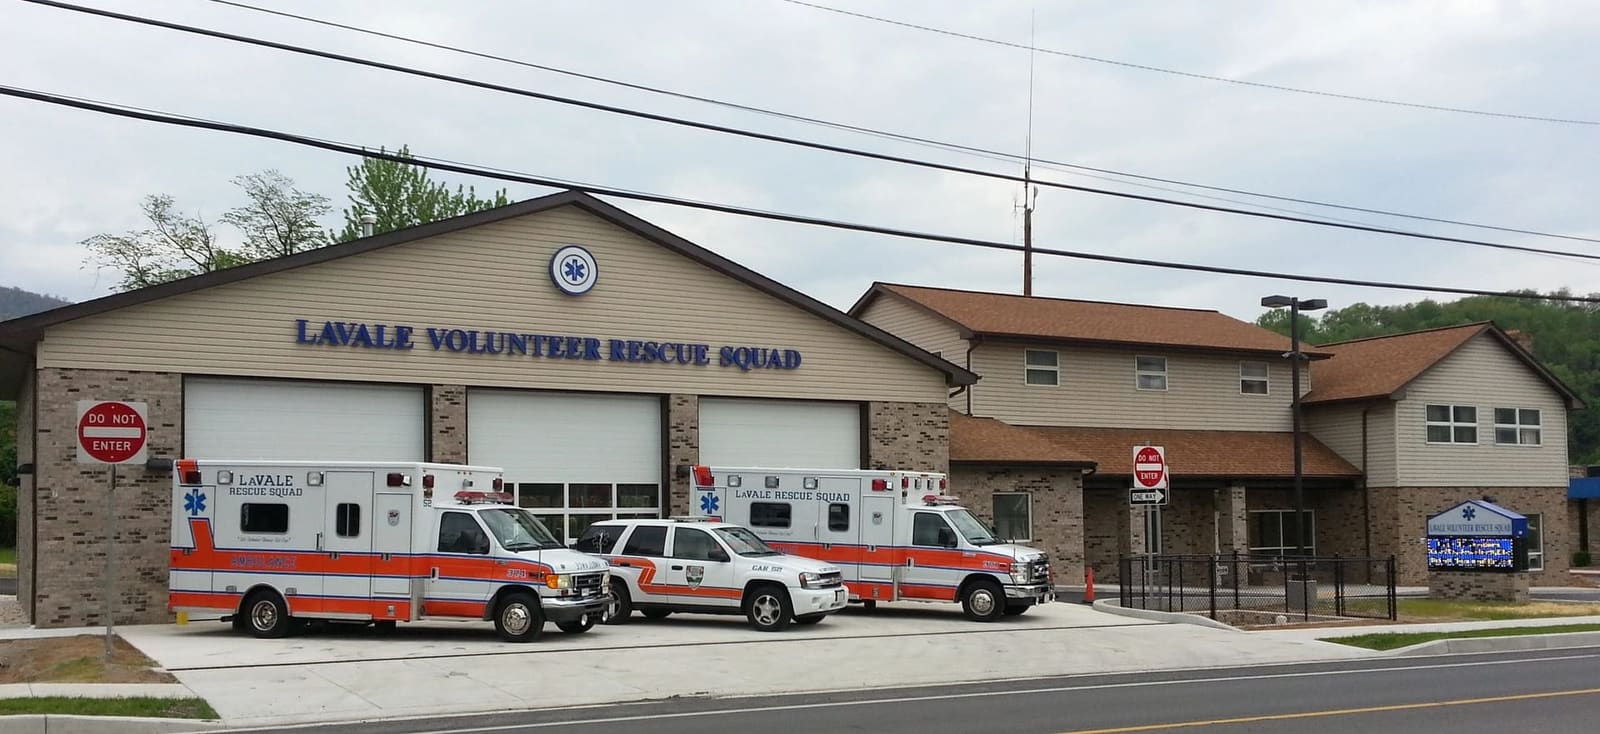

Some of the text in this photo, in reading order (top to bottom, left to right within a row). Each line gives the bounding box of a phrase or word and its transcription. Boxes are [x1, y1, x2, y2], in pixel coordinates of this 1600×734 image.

[296, 319, 802, 372] LAVALE VOLUNTEER RESCUE SQUAD
[89, 413, 136, 424] DO NOT
[93, 441, 131, 451] ENTER
[1138, 454, 1160, 462] DO NOT
[1141, 472, 1158, 480] ENTER
[229, 487, 303, 498] RESCUE SQUAD
[775, 491, 813, 501] RESCUE
[816, 493, 850, 503] SQUAD
[752, 564, 769, 572] CAR
